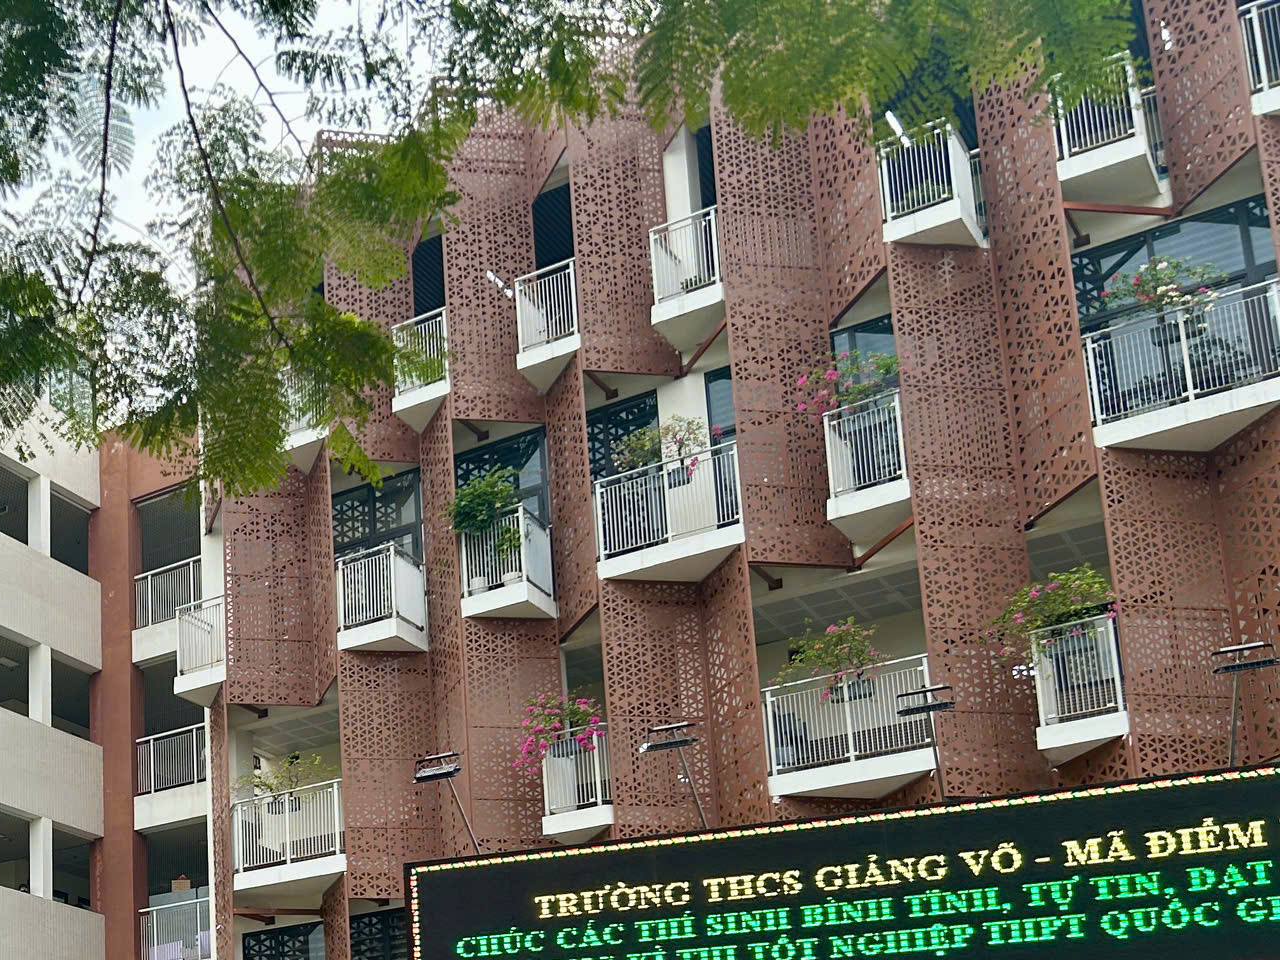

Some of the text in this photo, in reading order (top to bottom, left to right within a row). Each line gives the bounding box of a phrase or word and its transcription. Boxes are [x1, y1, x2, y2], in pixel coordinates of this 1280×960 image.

[534, 881, 691, 919] TRƯỜNG
[703, 870, 803, 902] THCS
[815, 854, 948, 891] GIẢNG
[958, 842, 1022, 876] VÕ
[1061, 830, 1136, 867] MÃ
[1144, 817, 1268, 858] ĐIỂM
[456, 926, 545, 957] CHÚC
[556, 919, 624, 949] CÁC
[634, 910, 697, 942] THÍ
[705, 907, 792, 937] SINH
[800, 897, 896, 927] BÌNH
[1022, 875, 1080, 910] TỰ
[828, 923, 974, 958] NGHIỆP
[982, 913, 1086, 944] THPT
[1100, 897, 1219, 940] QUỐC
[1236, 895, 1280, 923] GI
